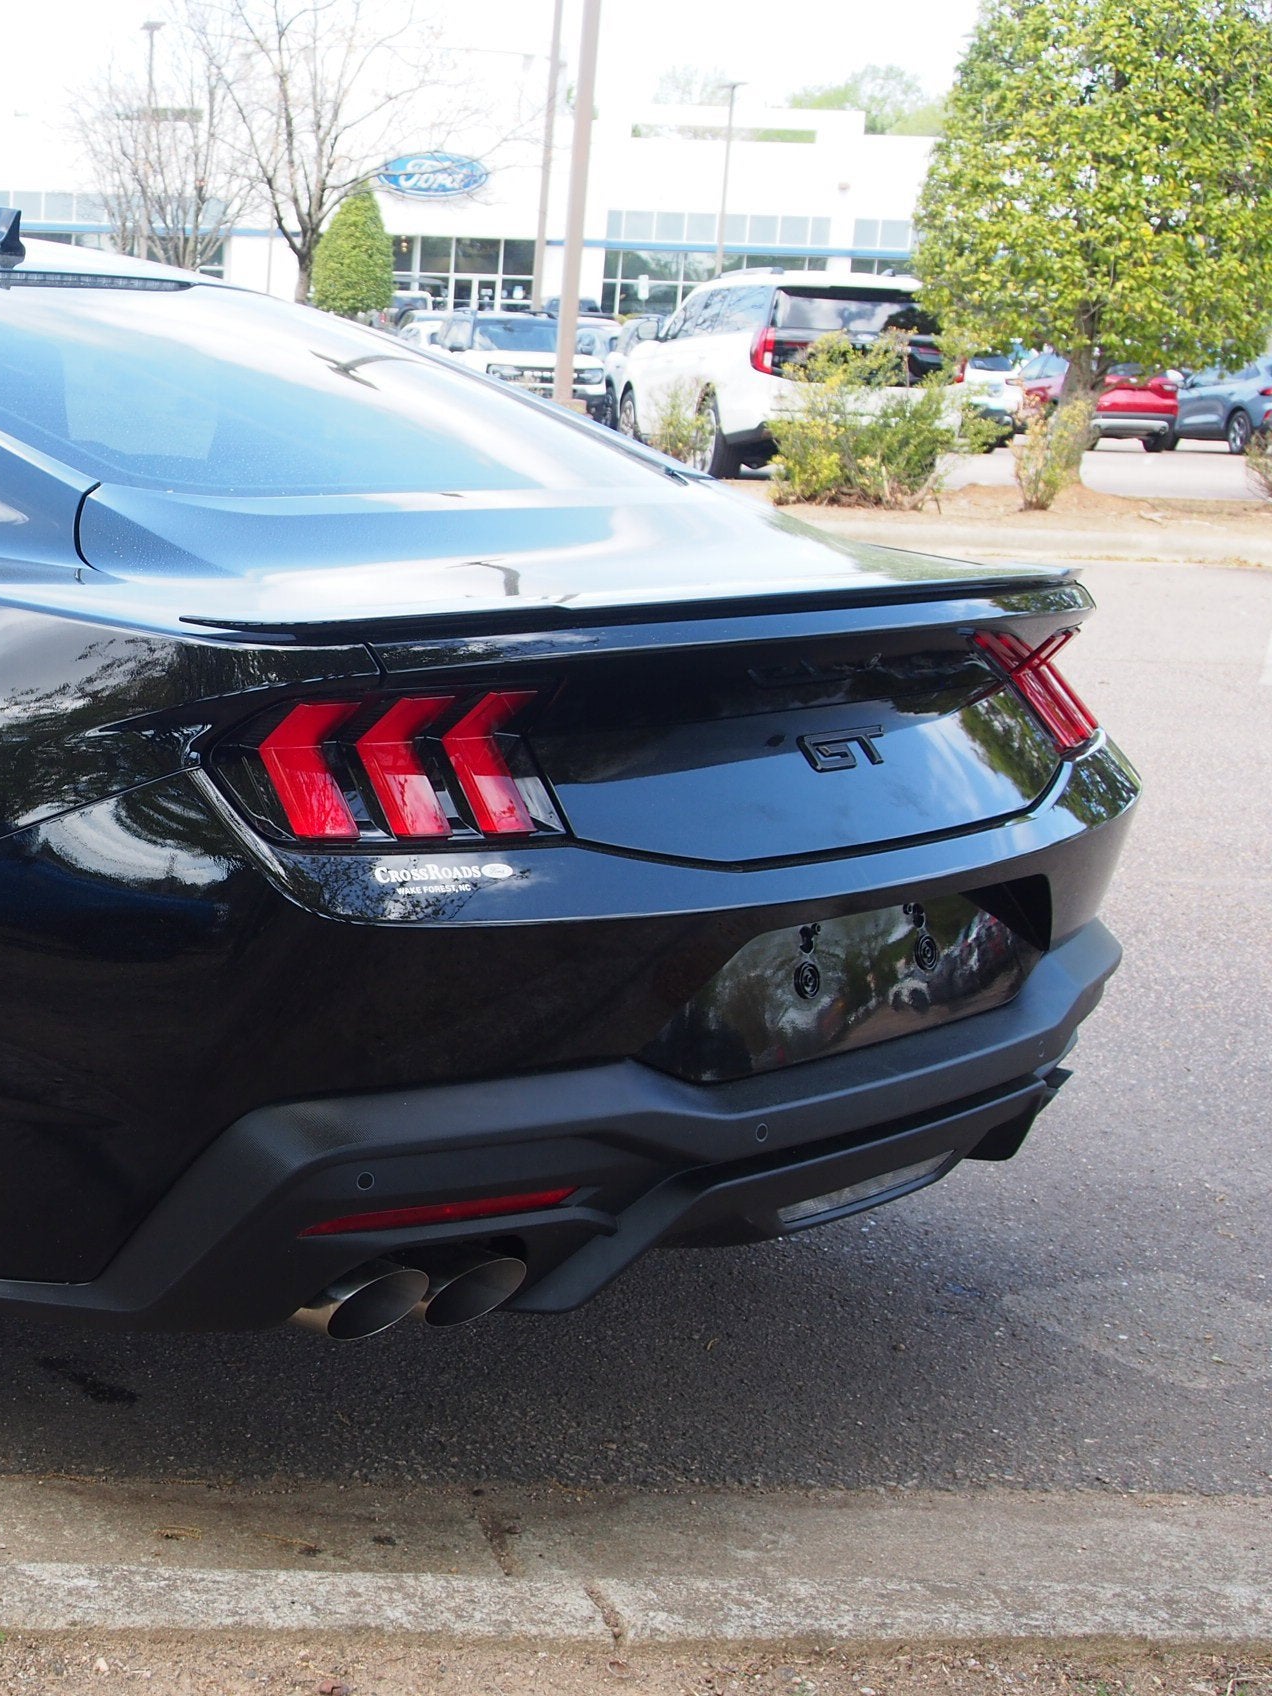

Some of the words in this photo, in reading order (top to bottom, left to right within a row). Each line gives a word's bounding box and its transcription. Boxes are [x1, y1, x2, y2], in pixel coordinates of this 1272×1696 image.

[397, 158, 476, 189] Ford
[796, 724, 884, 773] GT
[396, 885, 422, 895] WAKE
[423, 884, 458, 894] FOREST,
[459, 883, 472, 892] NC
